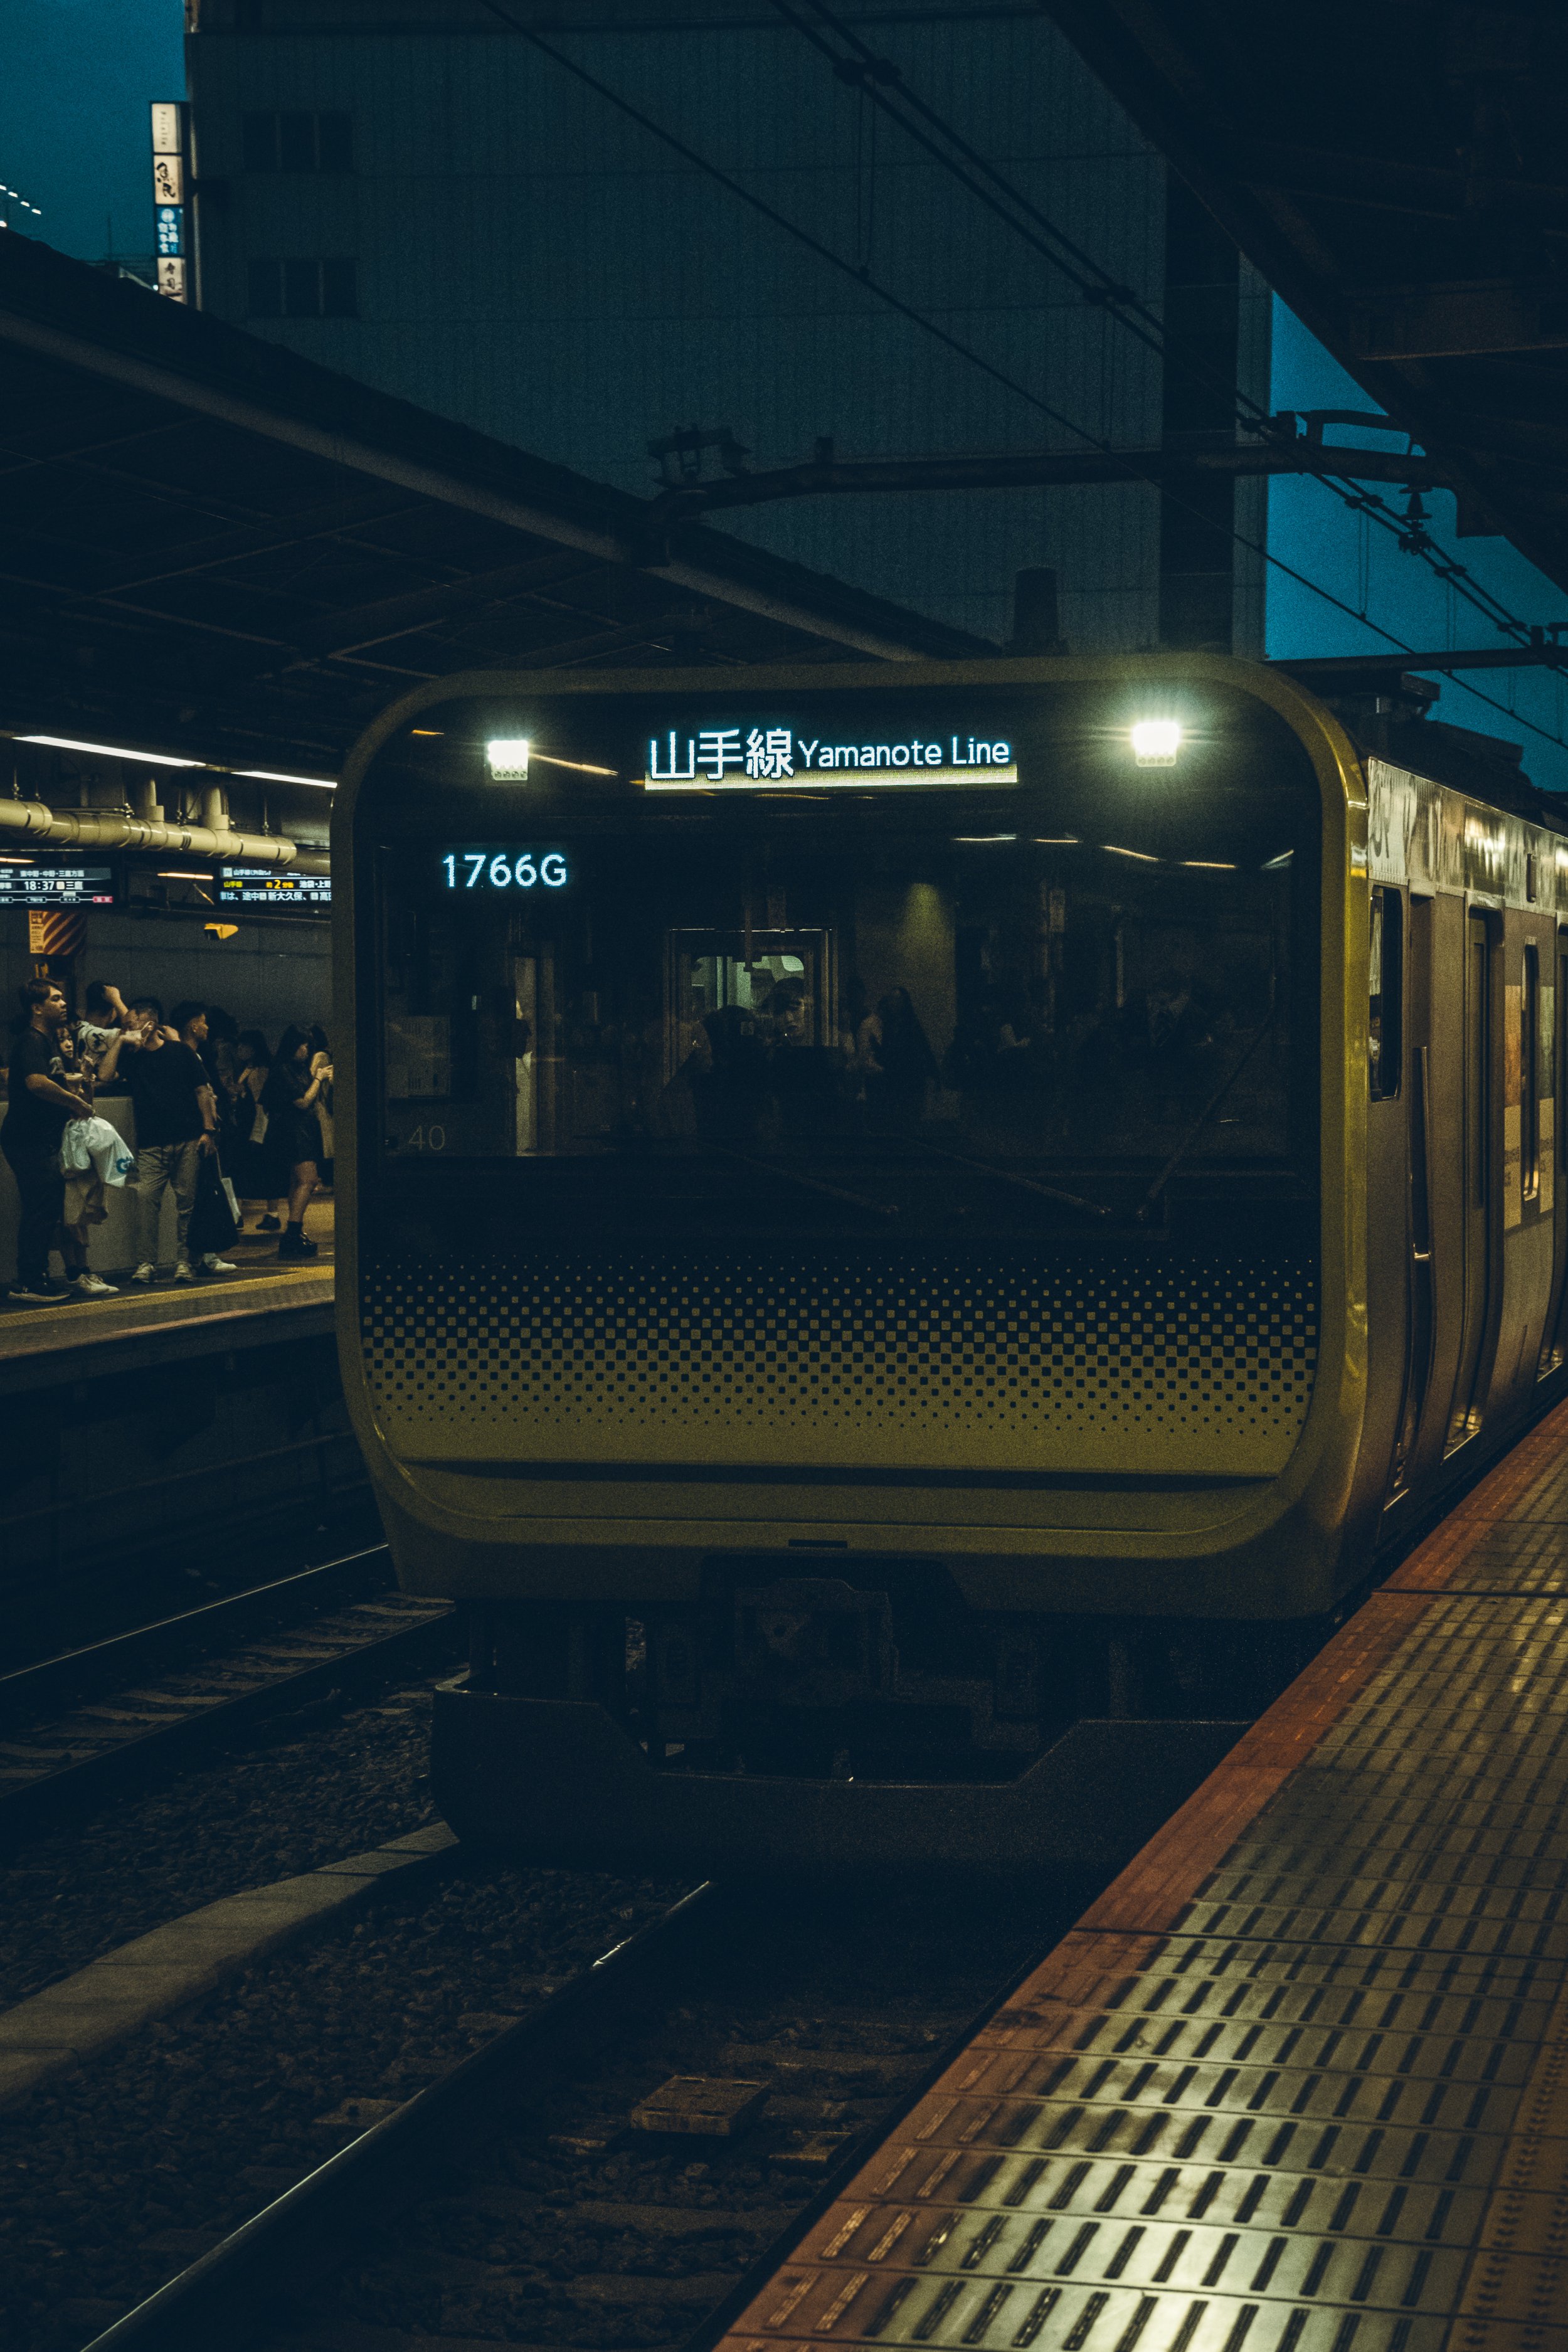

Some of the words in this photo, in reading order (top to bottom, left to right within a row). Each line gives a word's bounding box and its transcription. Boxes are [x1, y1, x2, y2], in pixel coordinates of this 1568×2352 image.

[651, 728, 794, 779] 山手線
[798, 739, 941, 768] Yamanote
[952, 736, 1009, 765] Line
[443, 854, 566, 887] 1766G
[24, 881, 55, 891] 18:37
[408, 1125, 445, 1150] 40
